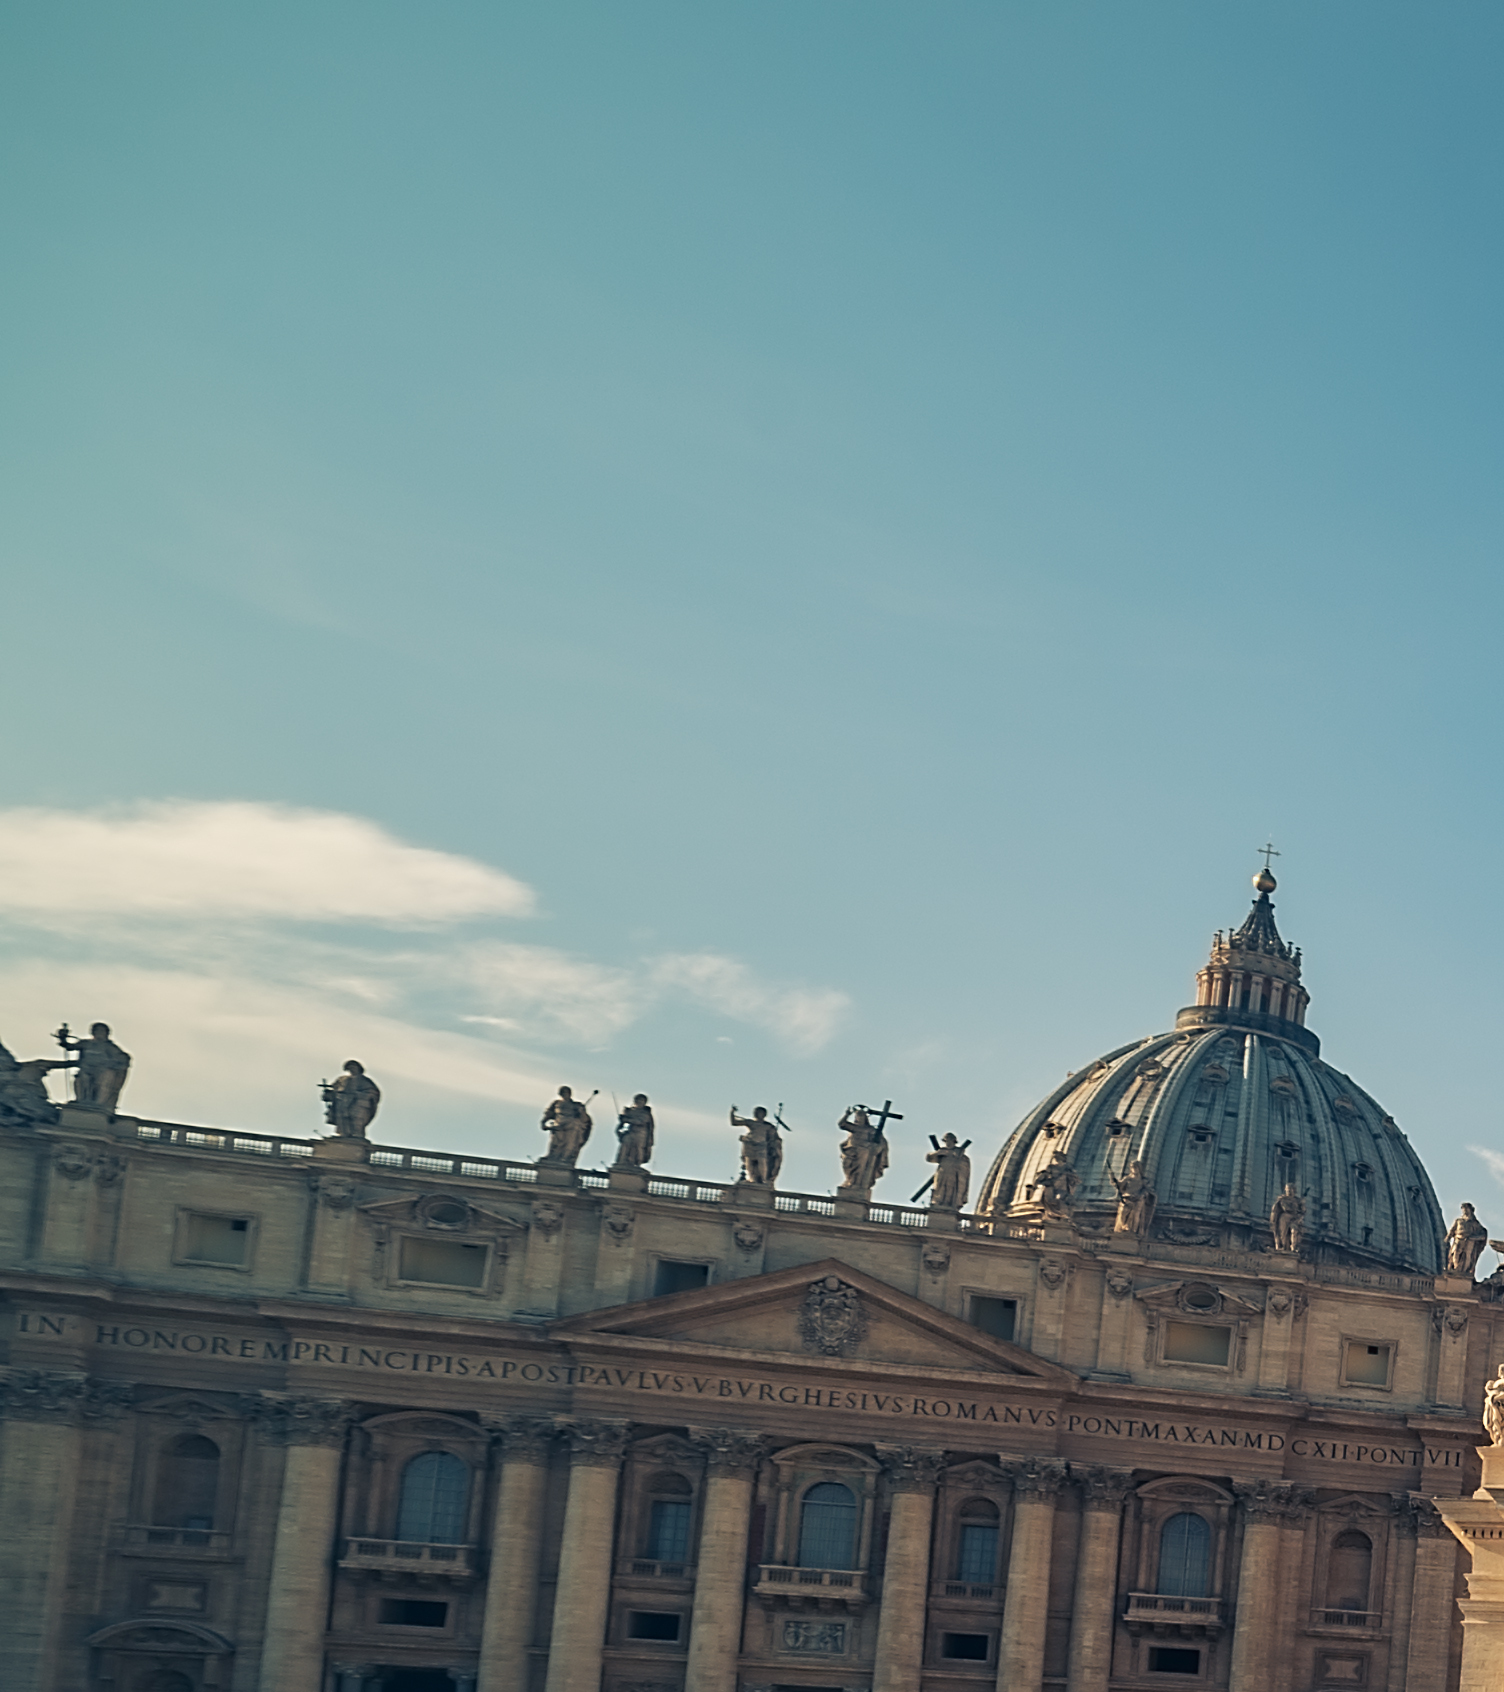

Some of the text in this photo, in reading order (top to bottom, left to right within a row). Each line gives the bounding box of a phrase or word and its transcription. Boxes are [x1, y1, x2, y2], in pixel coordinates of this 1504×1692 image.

[19, 1313, 66, 1336] IN
[96, 1324, 291, 1362] HONOREM
[293, 1341, 470, 1376] PRINCIPIS
[476, 1360, 578, 1386] APOST
[577, 1365, 685, 1393] PAVLVS
[692, 1376, 711, 1394] V
[718, 1379, 903, 1413] BVRGHESIVS
[911, 1397, 1057, 1427] ROMANVS
[1067, 1414, 1139, 1438] PONT
[1140, 1421, 1198, 1443] MAX
[1201, 1428, 1238, 1447] AN
[1356, 1445, 1422, 1467] PONT
[1426, 1449, 1462, 1468] VII
